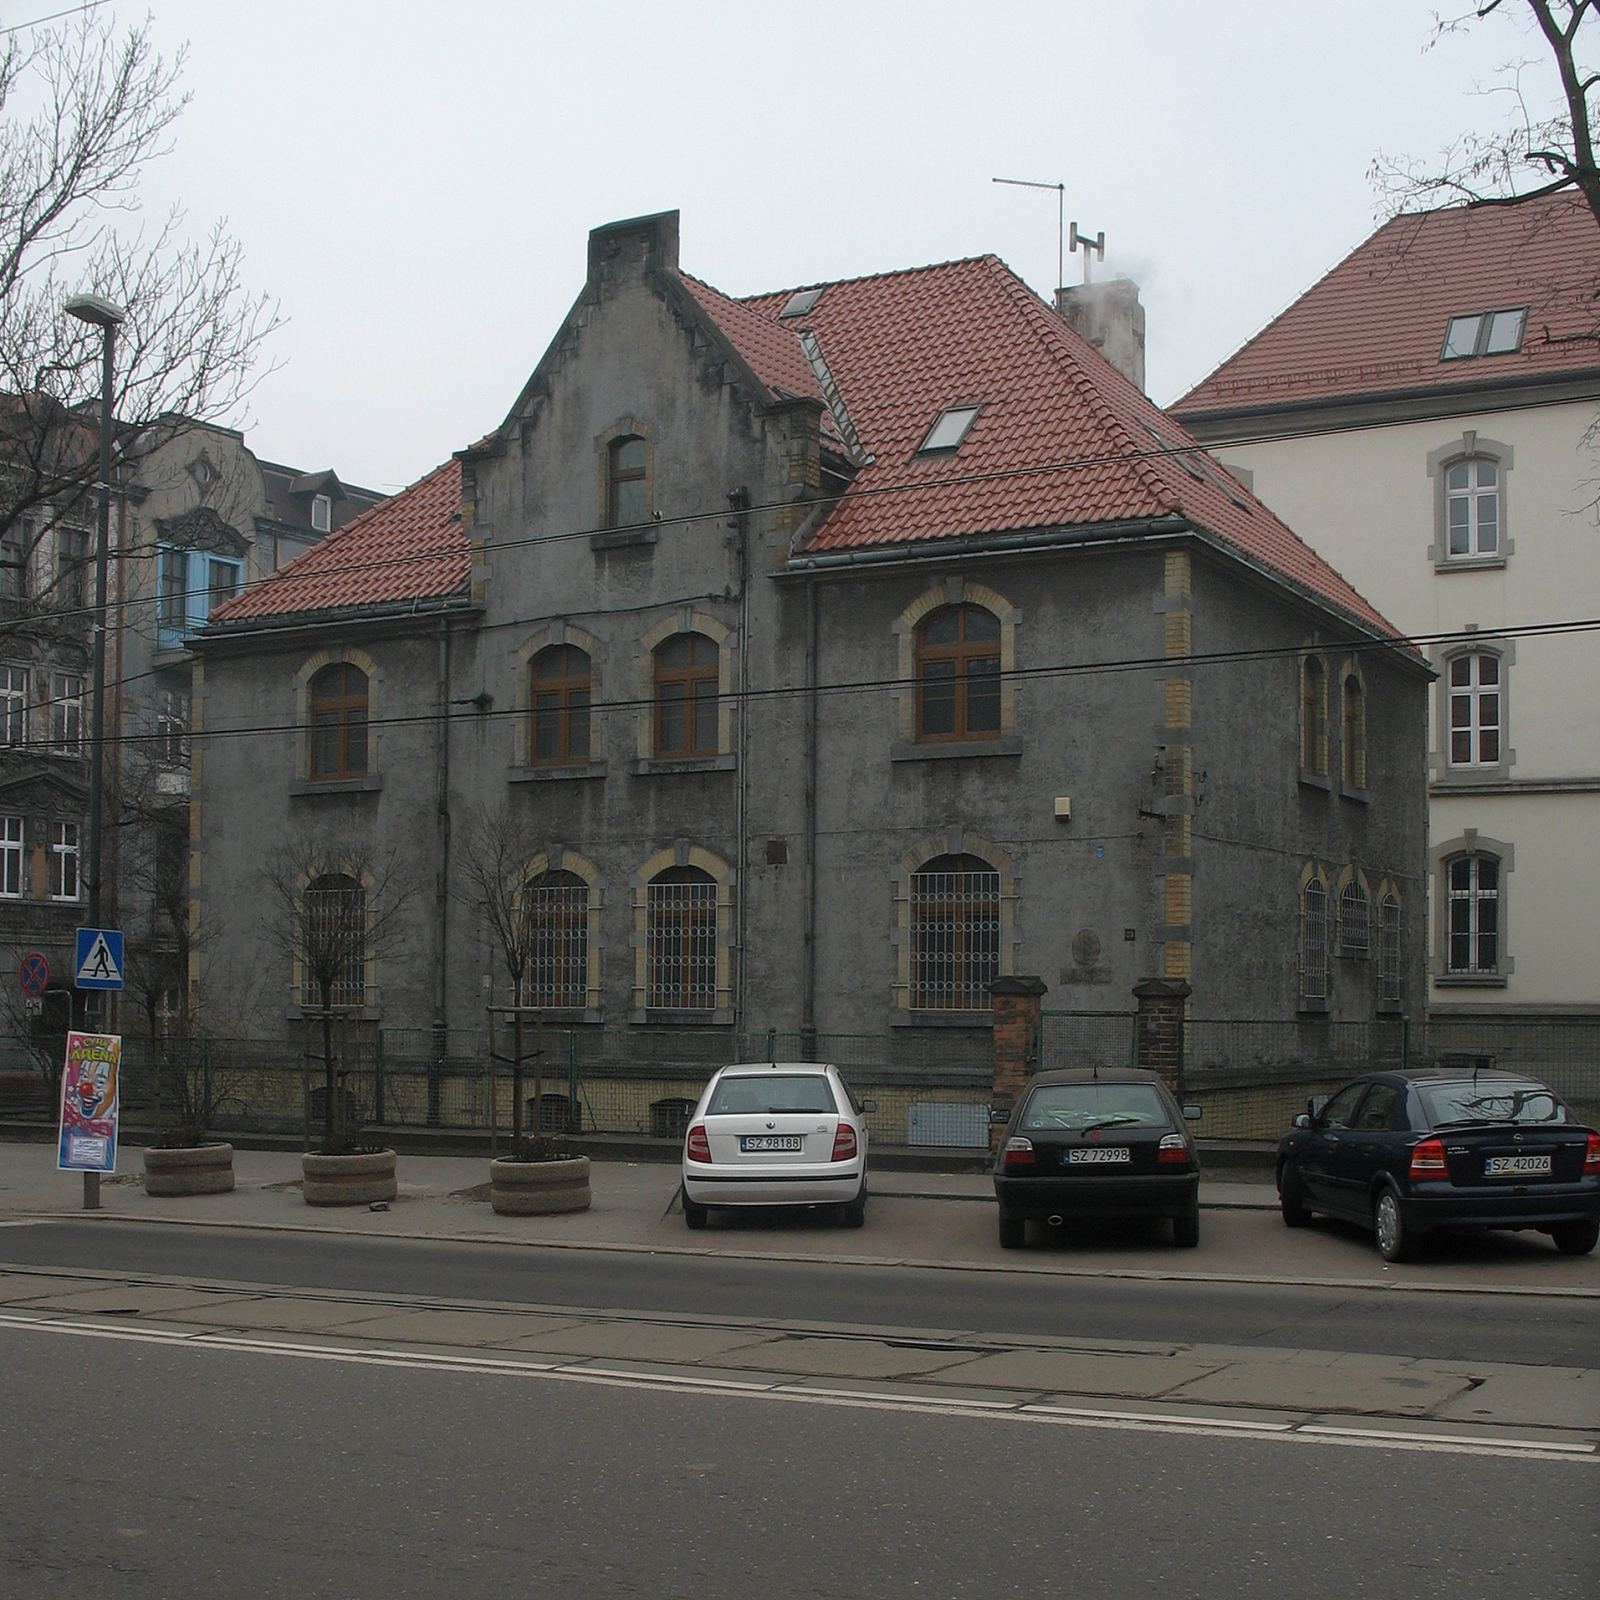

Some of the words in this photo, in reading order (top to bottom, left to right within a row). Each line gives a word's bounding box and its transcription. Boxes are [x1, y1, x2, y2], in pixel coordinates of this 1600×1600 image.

[71, 1049, 118, 1064] ARENA
[747, 1138, 763, 1149] SZ
[766, 1138, 799, 1149] 98188
[1071, 1150, 1088, 1162] SZ
[1092, 1149, 1128, 1161] 72998
[1492, 1159, 1509, 1170] SZ
[1513, 1157, 1549, 1170] 42026
